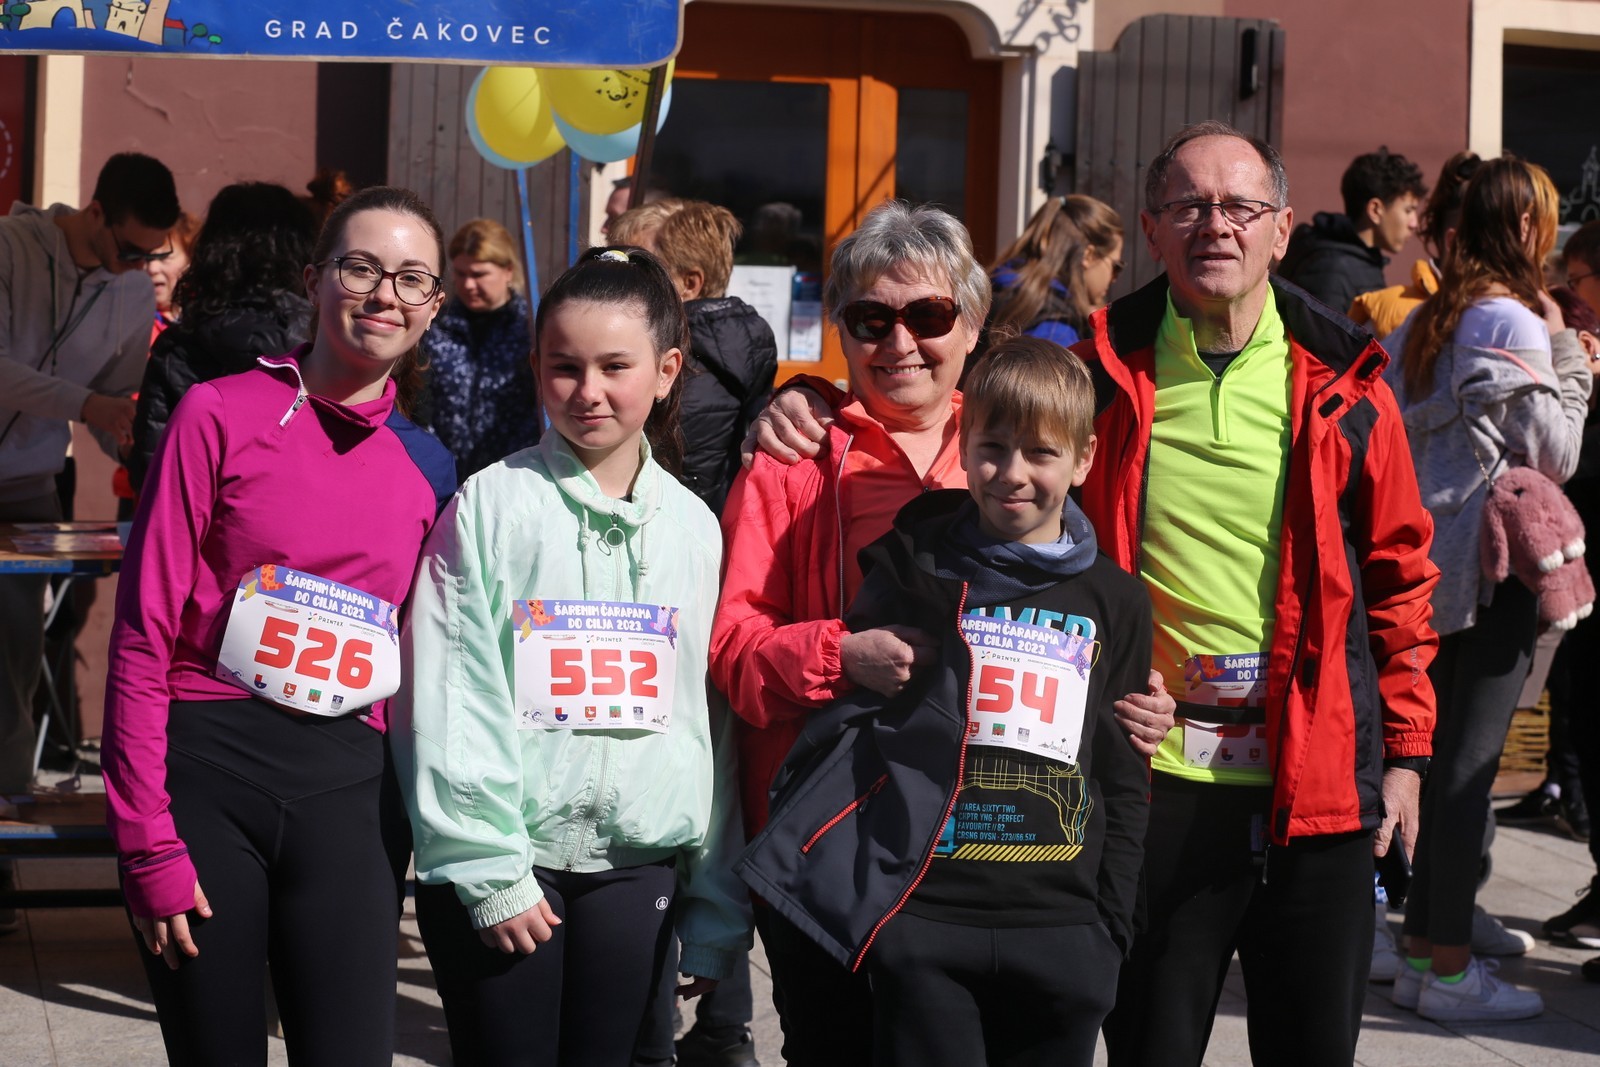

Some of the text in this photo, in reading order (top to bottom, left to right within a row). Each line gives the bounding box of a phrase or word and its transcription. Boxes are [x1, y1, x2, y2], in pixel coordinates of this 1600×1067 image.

[265, 17, 550, 45] GRAD ČAKOVEC
[284, 571, 329, 595] ŠARENIM
[329, 583, 375, 611] ČARAPAMA
[294, 591, 310, 605] DO
[312, 594, 339, 612] CILJA
[341, 603, 366, 621] 2023.
[554, 602, 652, 620] ŠARENIM ČARAPAMA
[568, 618, 644, 632] DO CILJA 2023.
[961, 618, 1001, 634] ARENIM
[1002, 622, 1059, 646] ČARAPAMA
[254, 616, 374, 690] 526
[966, 633, 1047, 656] DO CILJA 2023.
[550, 648, 658, 699] 552
[1237, 670, 1251, 680] DO
[997, 813, 1025, 823] PERFECT
